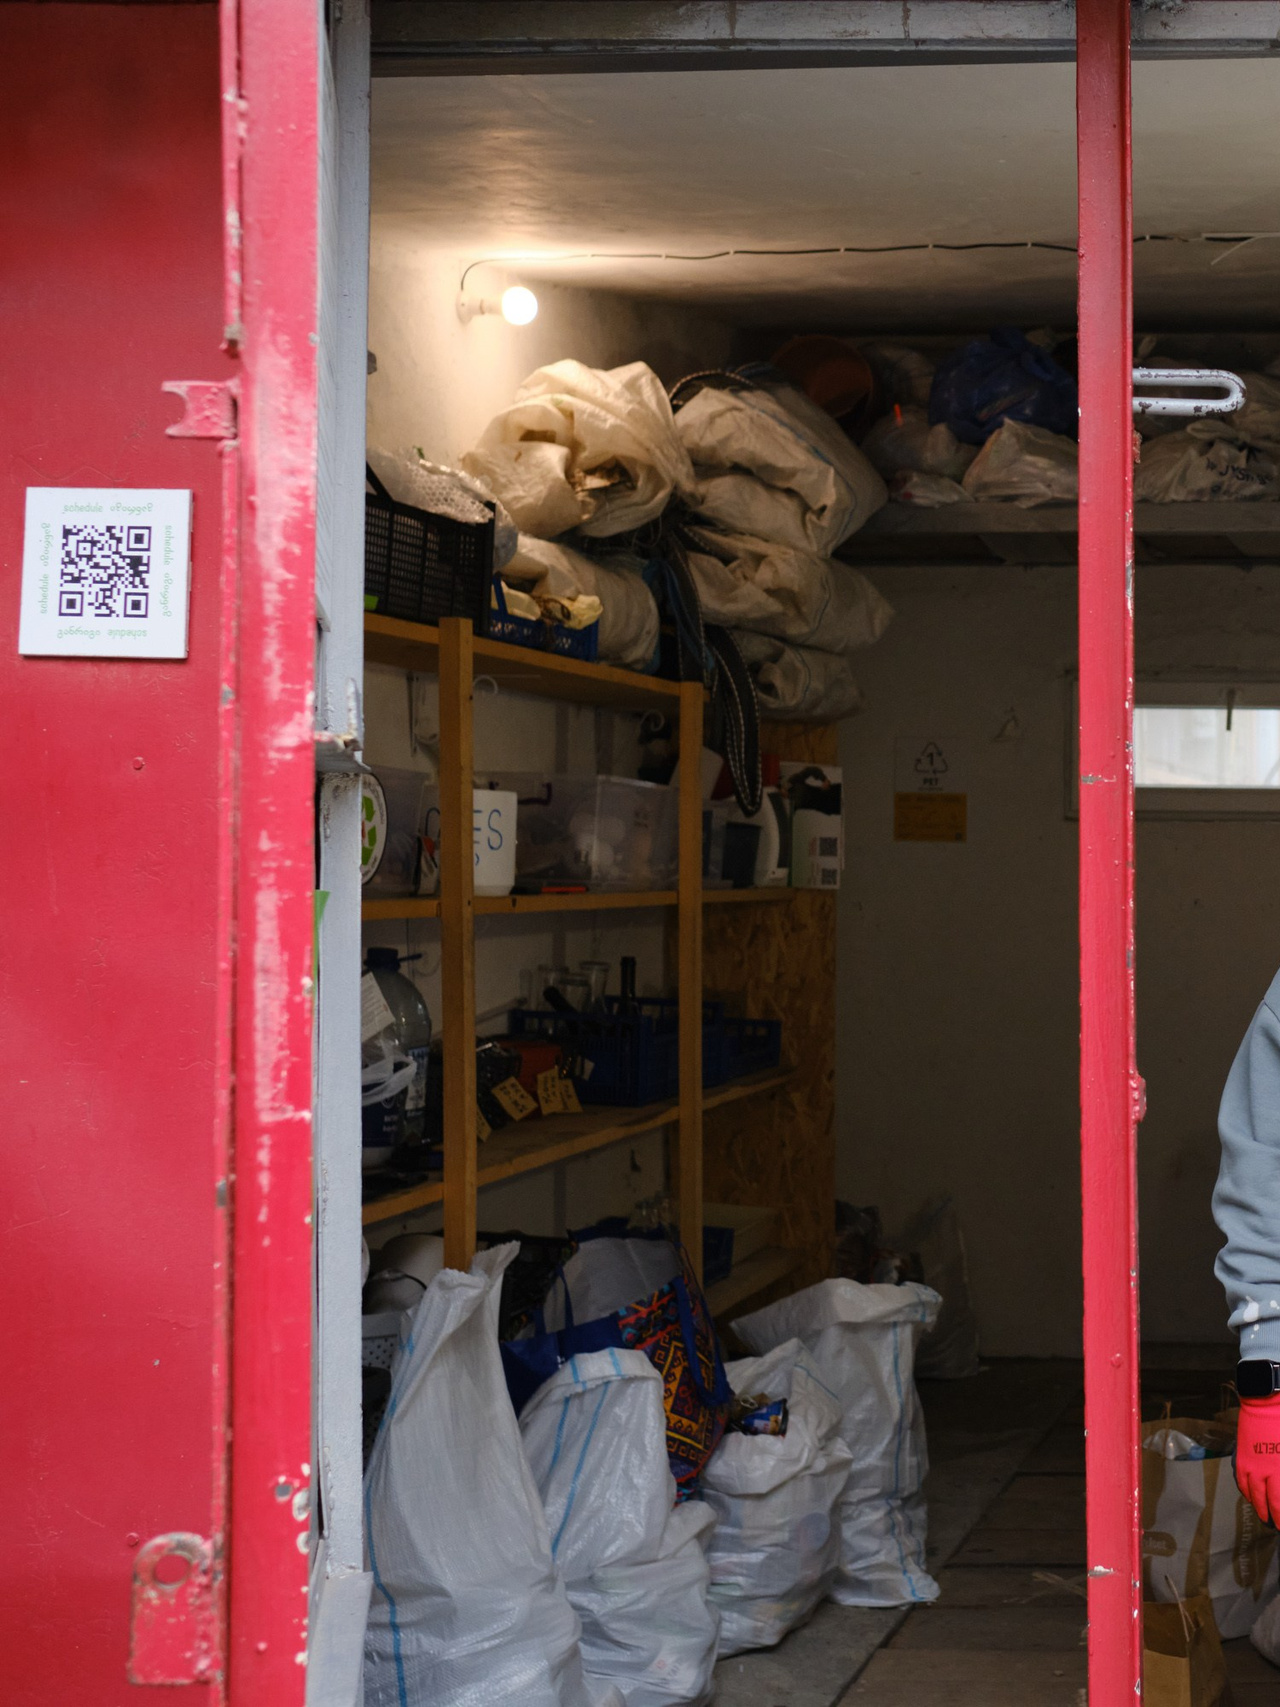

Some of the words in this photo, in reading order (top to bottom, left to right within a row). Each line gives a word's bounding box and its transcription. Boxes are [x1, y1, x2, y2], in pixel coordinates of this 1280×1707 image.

[63, 503, 103, 513] schedule
[110, 502, 153, 515] განრიგი
[40, 522, 54, 566] განრიგი
[163, 525, 175, 566] schedule
[38, 574, 50, 614] schedule
[159, 572, 173, 617] განრიგი
[57, 625, 101, 639] განრიგი
[108, 629, 148, 639] schedule
[926, 752, 934, 766] 1
[922, 777, 939, 786] PET
